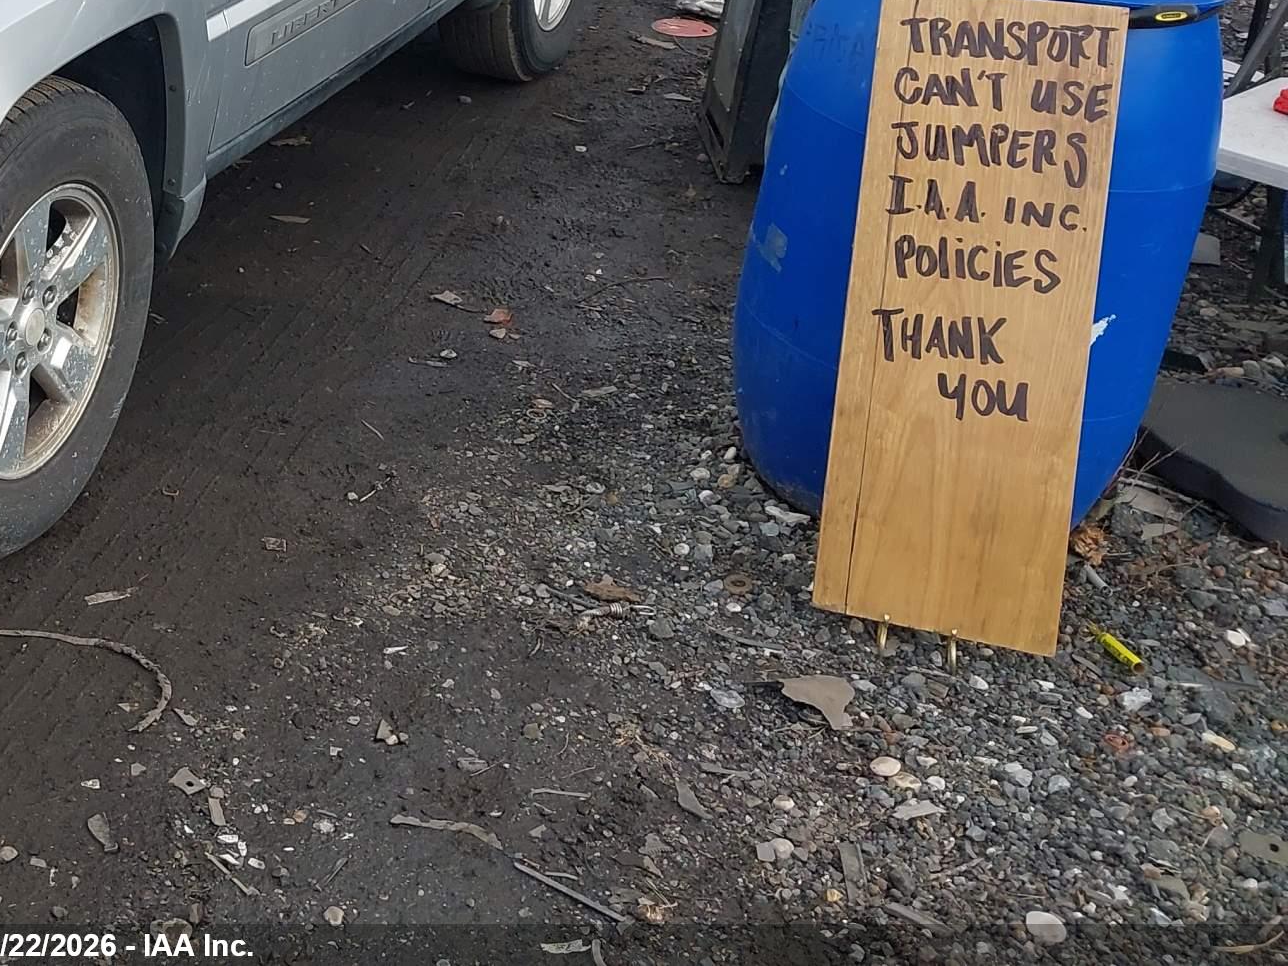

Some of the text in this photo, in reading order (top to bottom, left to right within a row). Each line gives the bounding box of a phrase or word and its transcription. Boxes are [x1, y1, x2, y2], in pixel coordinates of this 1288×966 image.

[900, 17, 1120, 69] TRANSPORT
[893, 66, 1113, 123] CAN'T USE
[891, 120, 1089, 189] JUMPERS
[1003, 196, 1088, 233] INC.
[871, 307, 1008, 366] THANK
[937, 372, 1030, 423] YOU
